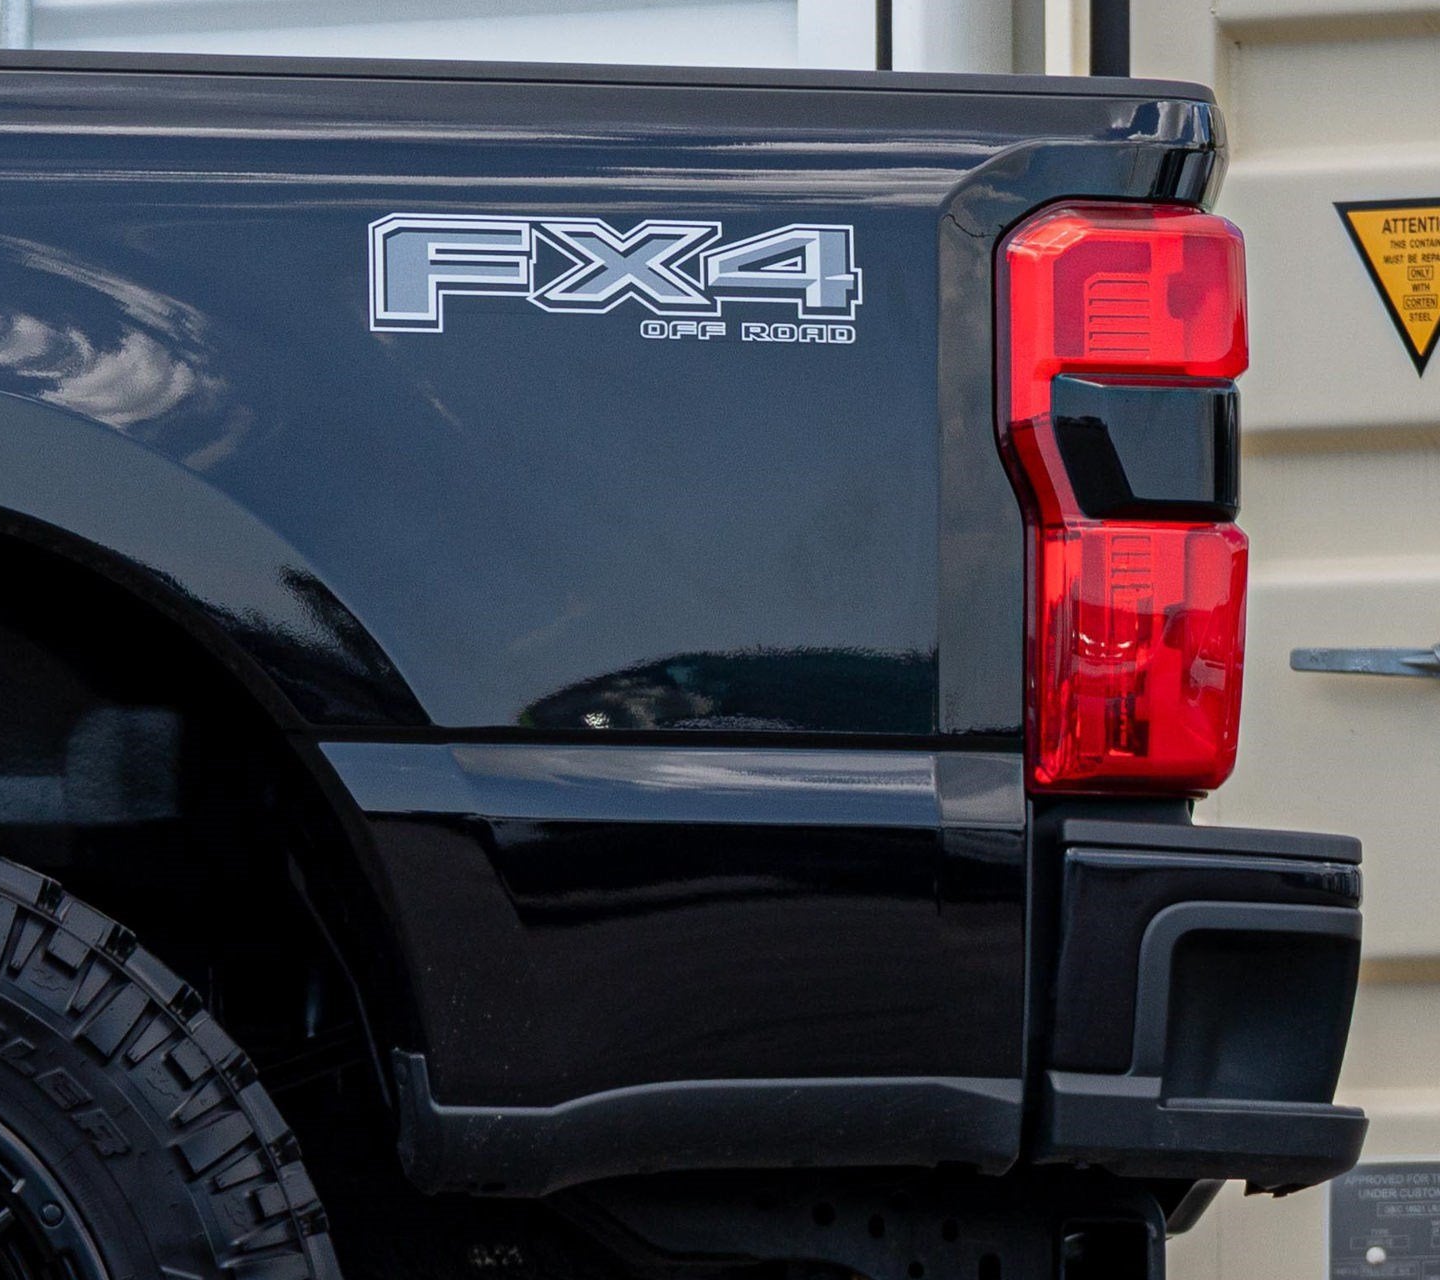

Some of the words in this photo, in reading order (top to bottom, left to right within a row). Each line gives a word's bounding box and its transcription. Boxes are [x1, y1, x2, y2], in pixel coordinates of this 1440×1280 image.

[1390, 239, 1406, 248] THIS
[1383, 255, 1403, 264] MUST
[1408, 254, 1418, 263] BE
[368, 213, 863, 333] FX4
[1410, 268, 1430, 278] ONLY
[1411, 282, 1430, 292] WITH
[1405, 297, 1436, 308] CORTEN
[1409, 312, 1432, 322] STEEL
[640, 320, 726, 340] OFF
[741, 322, 856, 345] ROAD
[1344, 1173, 1405, 1186] APPROVED
[1406, 1173, 1431, 1185] FOR
[1358, 1188, 1397, 1199] UNDER
